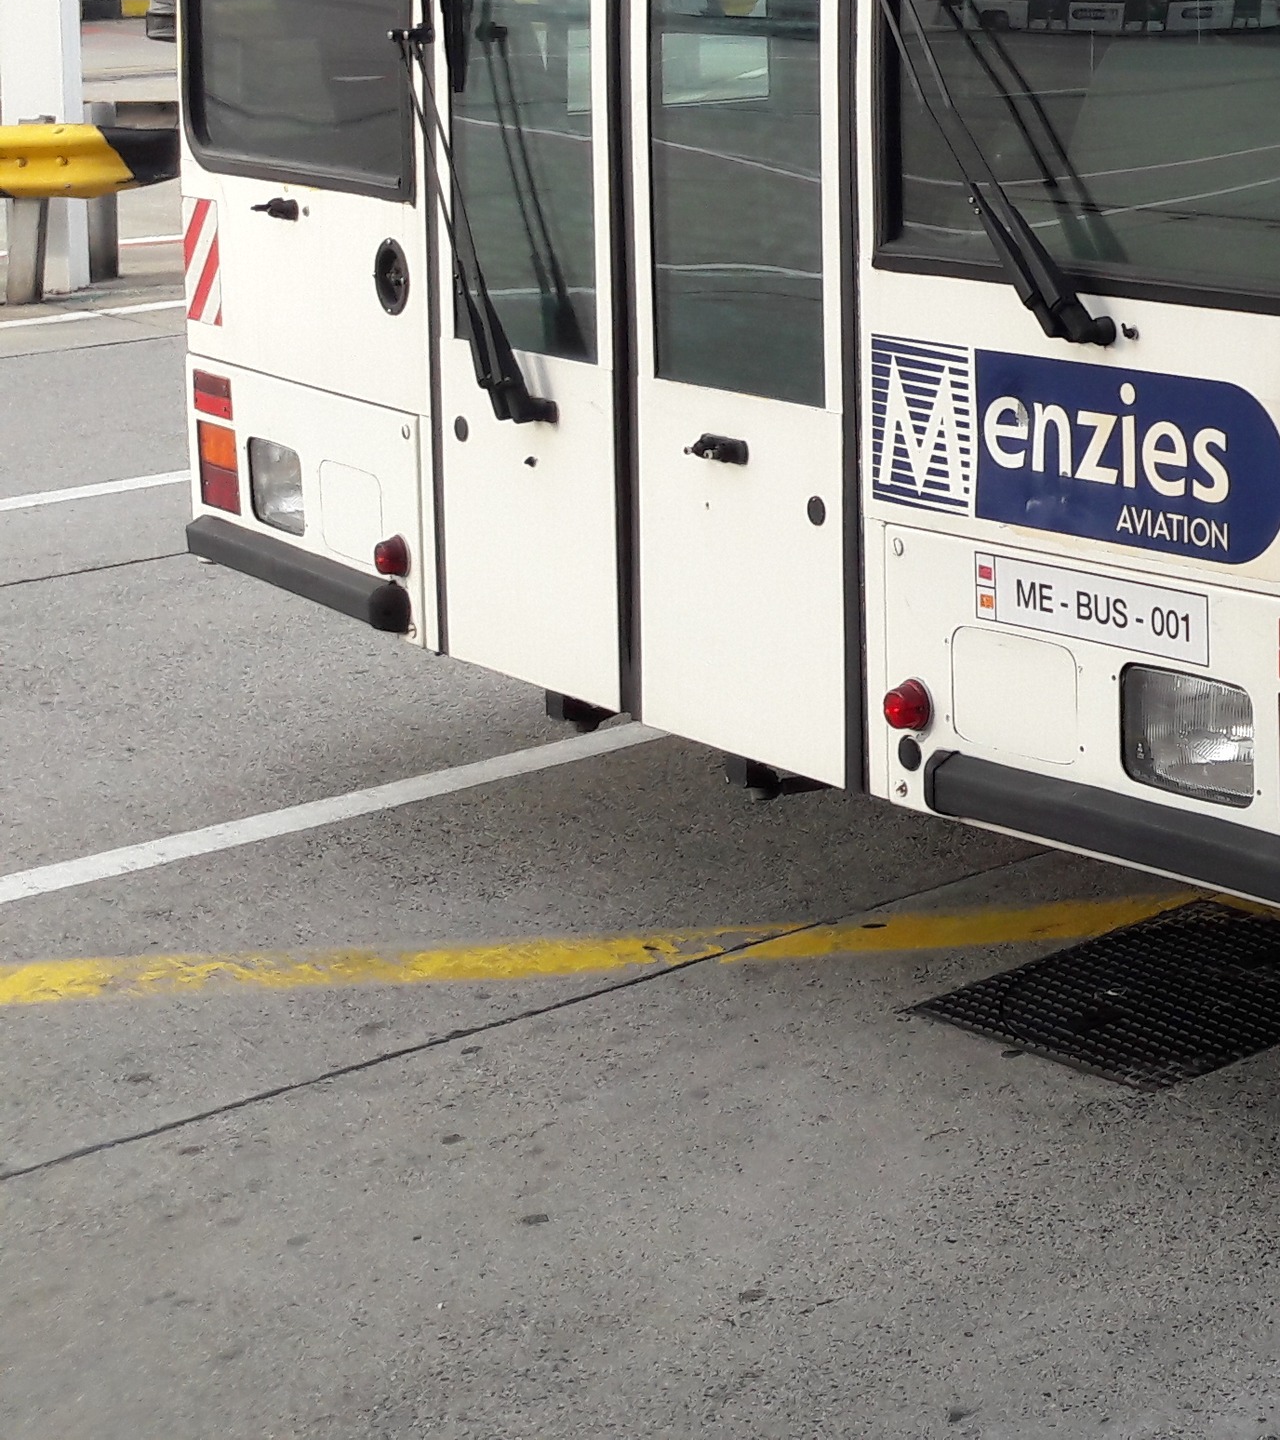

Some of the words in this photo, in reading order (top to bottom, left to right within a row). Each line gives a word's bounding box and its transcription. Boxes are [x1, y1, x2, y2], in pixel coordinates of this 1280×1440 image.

[878, 355, 1231, 504] Menzies
[1116, 505, 1229, 552] AVIATION
[1016, 578, 1054, 614] ME
[1076, 590, 1128, 629] BUS
[1151, 606, 1190, 642] 001
